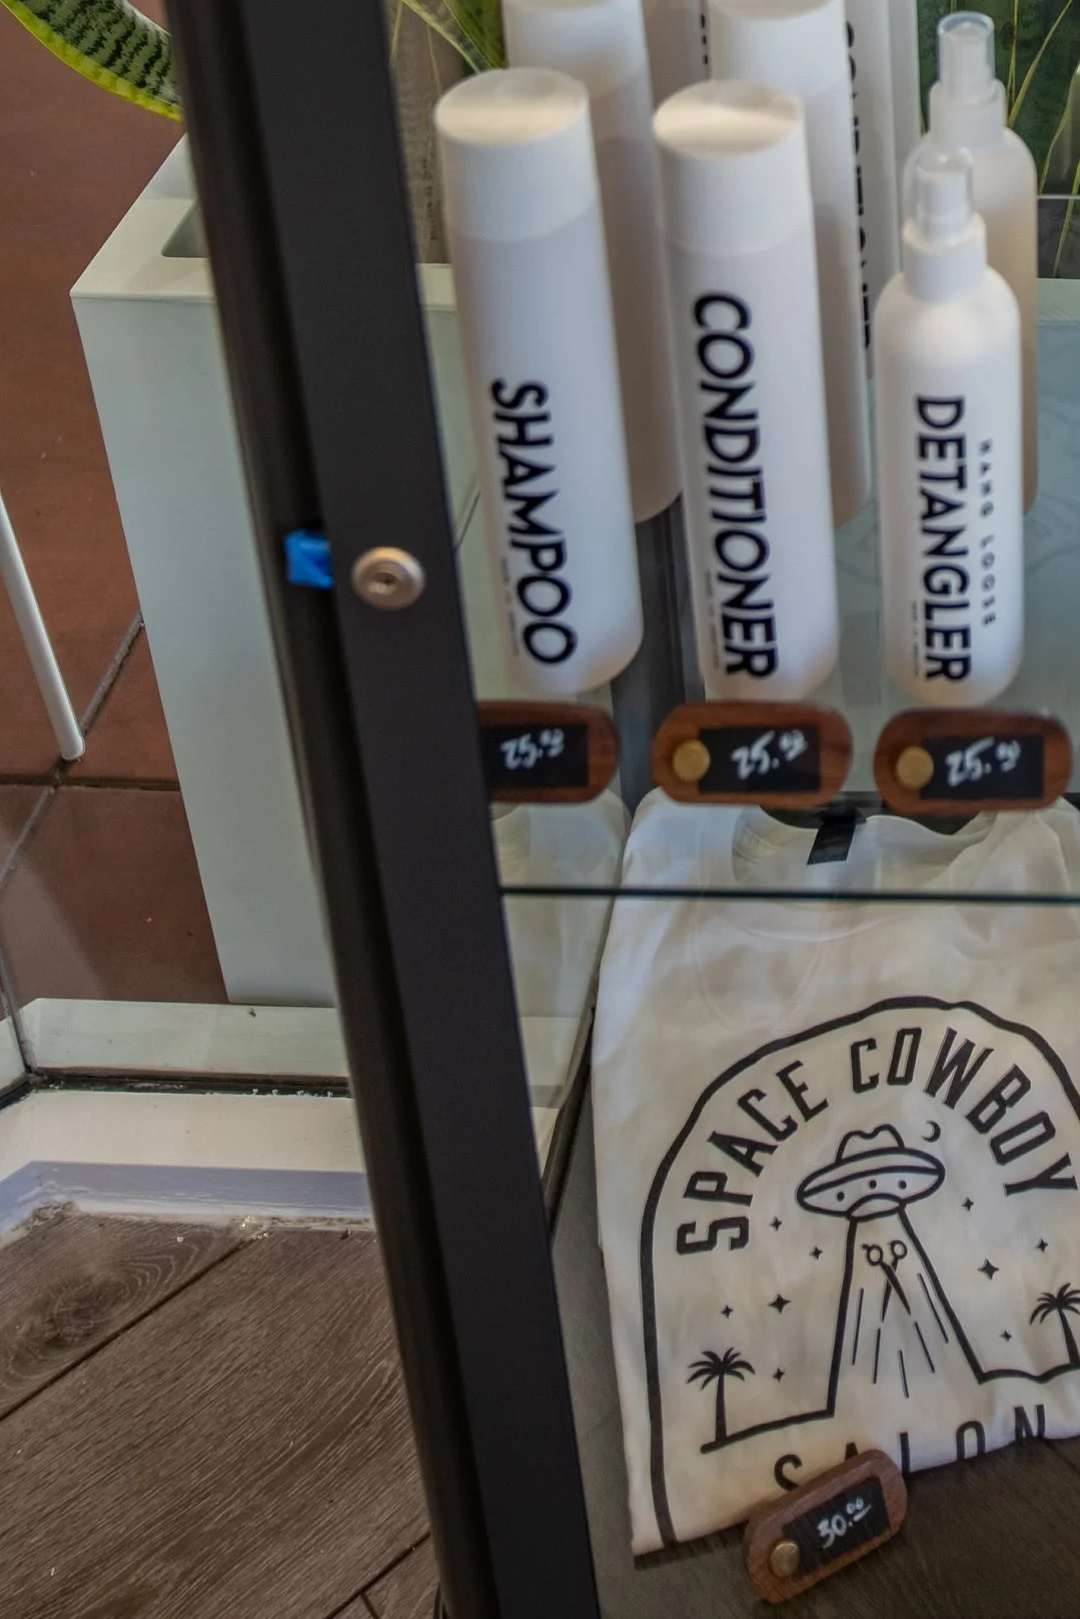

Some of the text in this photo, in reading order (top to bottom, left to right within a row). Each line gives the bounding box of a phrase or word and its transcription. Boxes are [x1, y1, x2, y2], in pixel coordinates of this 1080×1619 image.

[490, 378, 578, 665] SHAMPOO
[693, 292, 778, 680] CONDITIONER
[917, 395, 972, 683] DETANGLER
[676, 1027, 1078, 1255] SPACE COWBOY
